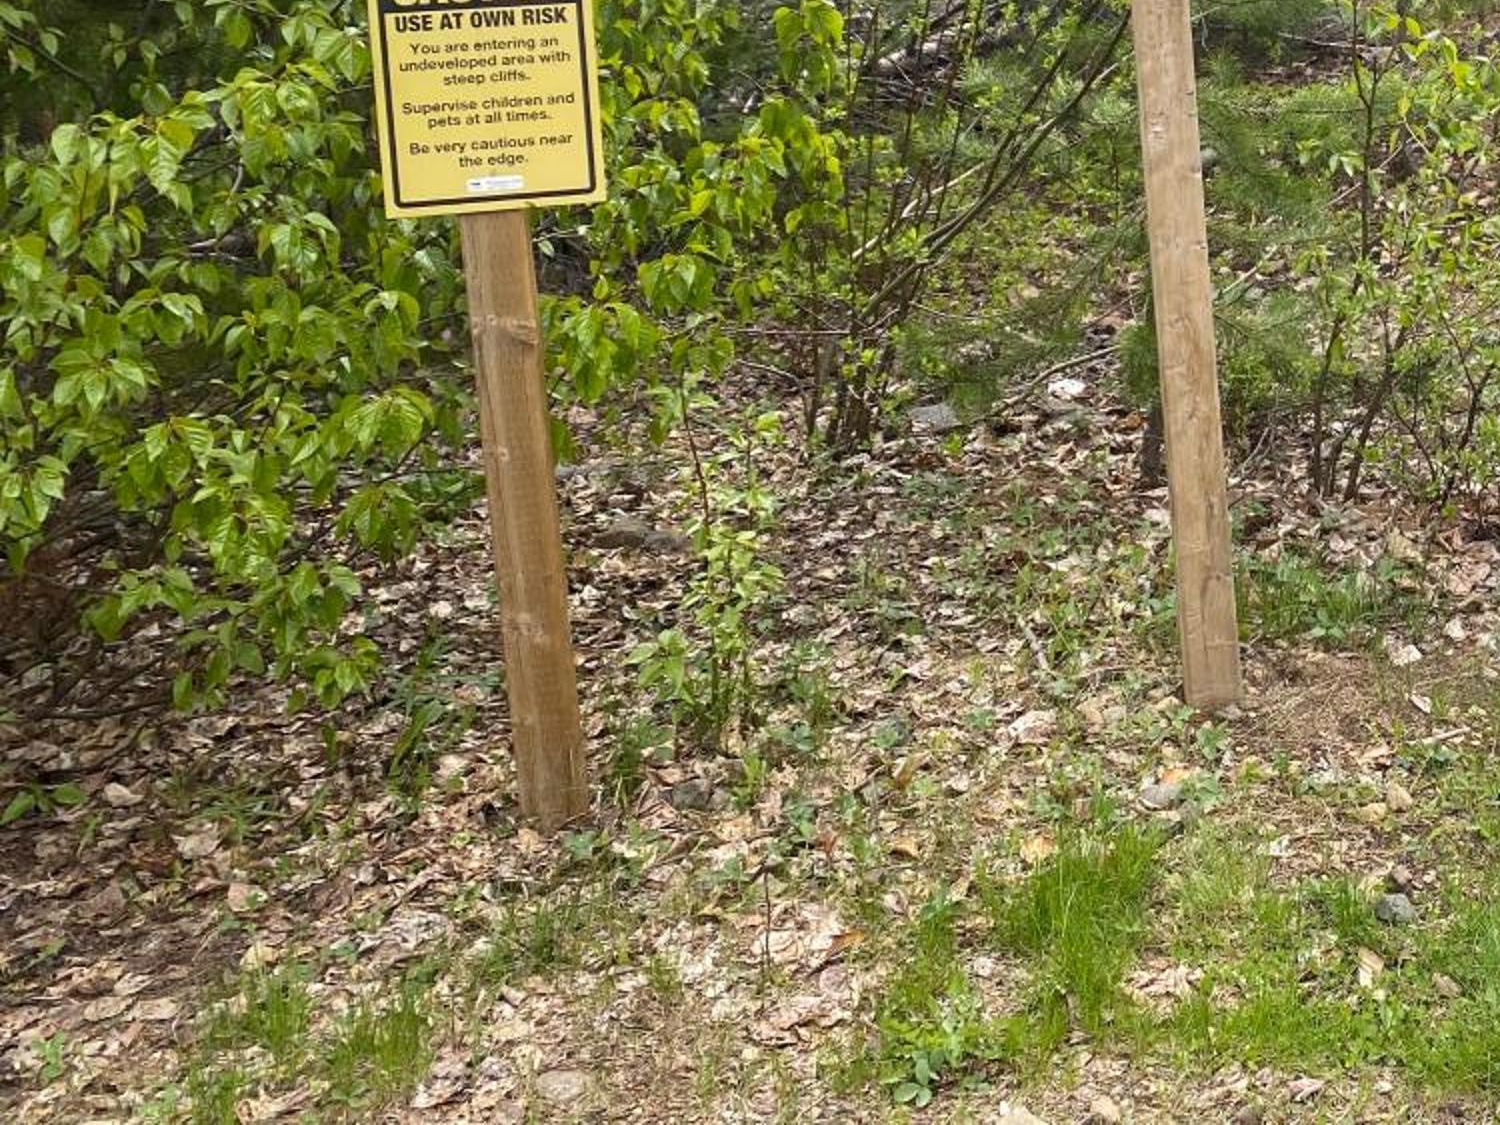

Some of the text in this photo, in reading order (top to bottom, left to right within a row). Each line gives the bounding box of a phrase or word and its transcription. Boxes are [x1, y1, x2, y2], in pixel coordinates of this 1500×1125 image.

[395, 7, 568, 33] USE AT OWN RISK
[410, 37, 558, 55] You are entering an
[400, 51, 570, 73] undeveloped area with
[444, 69, 532, 87] steep cliffs.
[402, 93, 574, 115] Supervise children and
[428, 109, 552, 129] pets at all times.
[410, 133, 572, 155] Be very cautious near
[459, 153, 528, 167] the edge.
